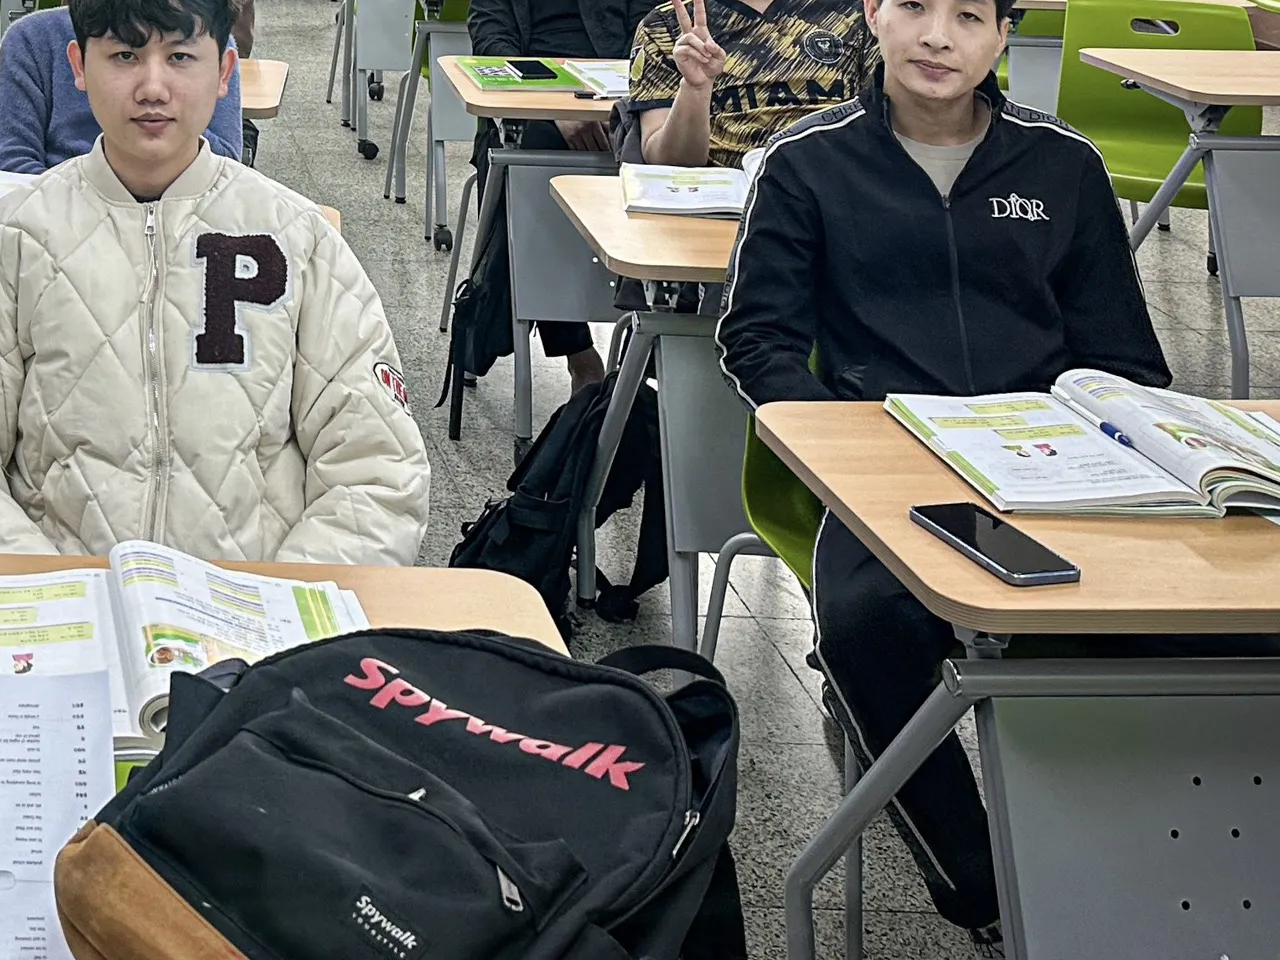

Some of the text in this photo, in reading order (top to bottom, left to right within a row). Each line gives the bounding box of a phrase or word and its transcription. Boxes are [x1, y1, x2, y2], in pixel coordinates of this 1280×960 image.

[989, 193, 1050, 221] DIOR
[196, 233, 288, 364] P
[343, 657, 645, 791] Spywalk
[356, 895, 418, 950] Spywalk
